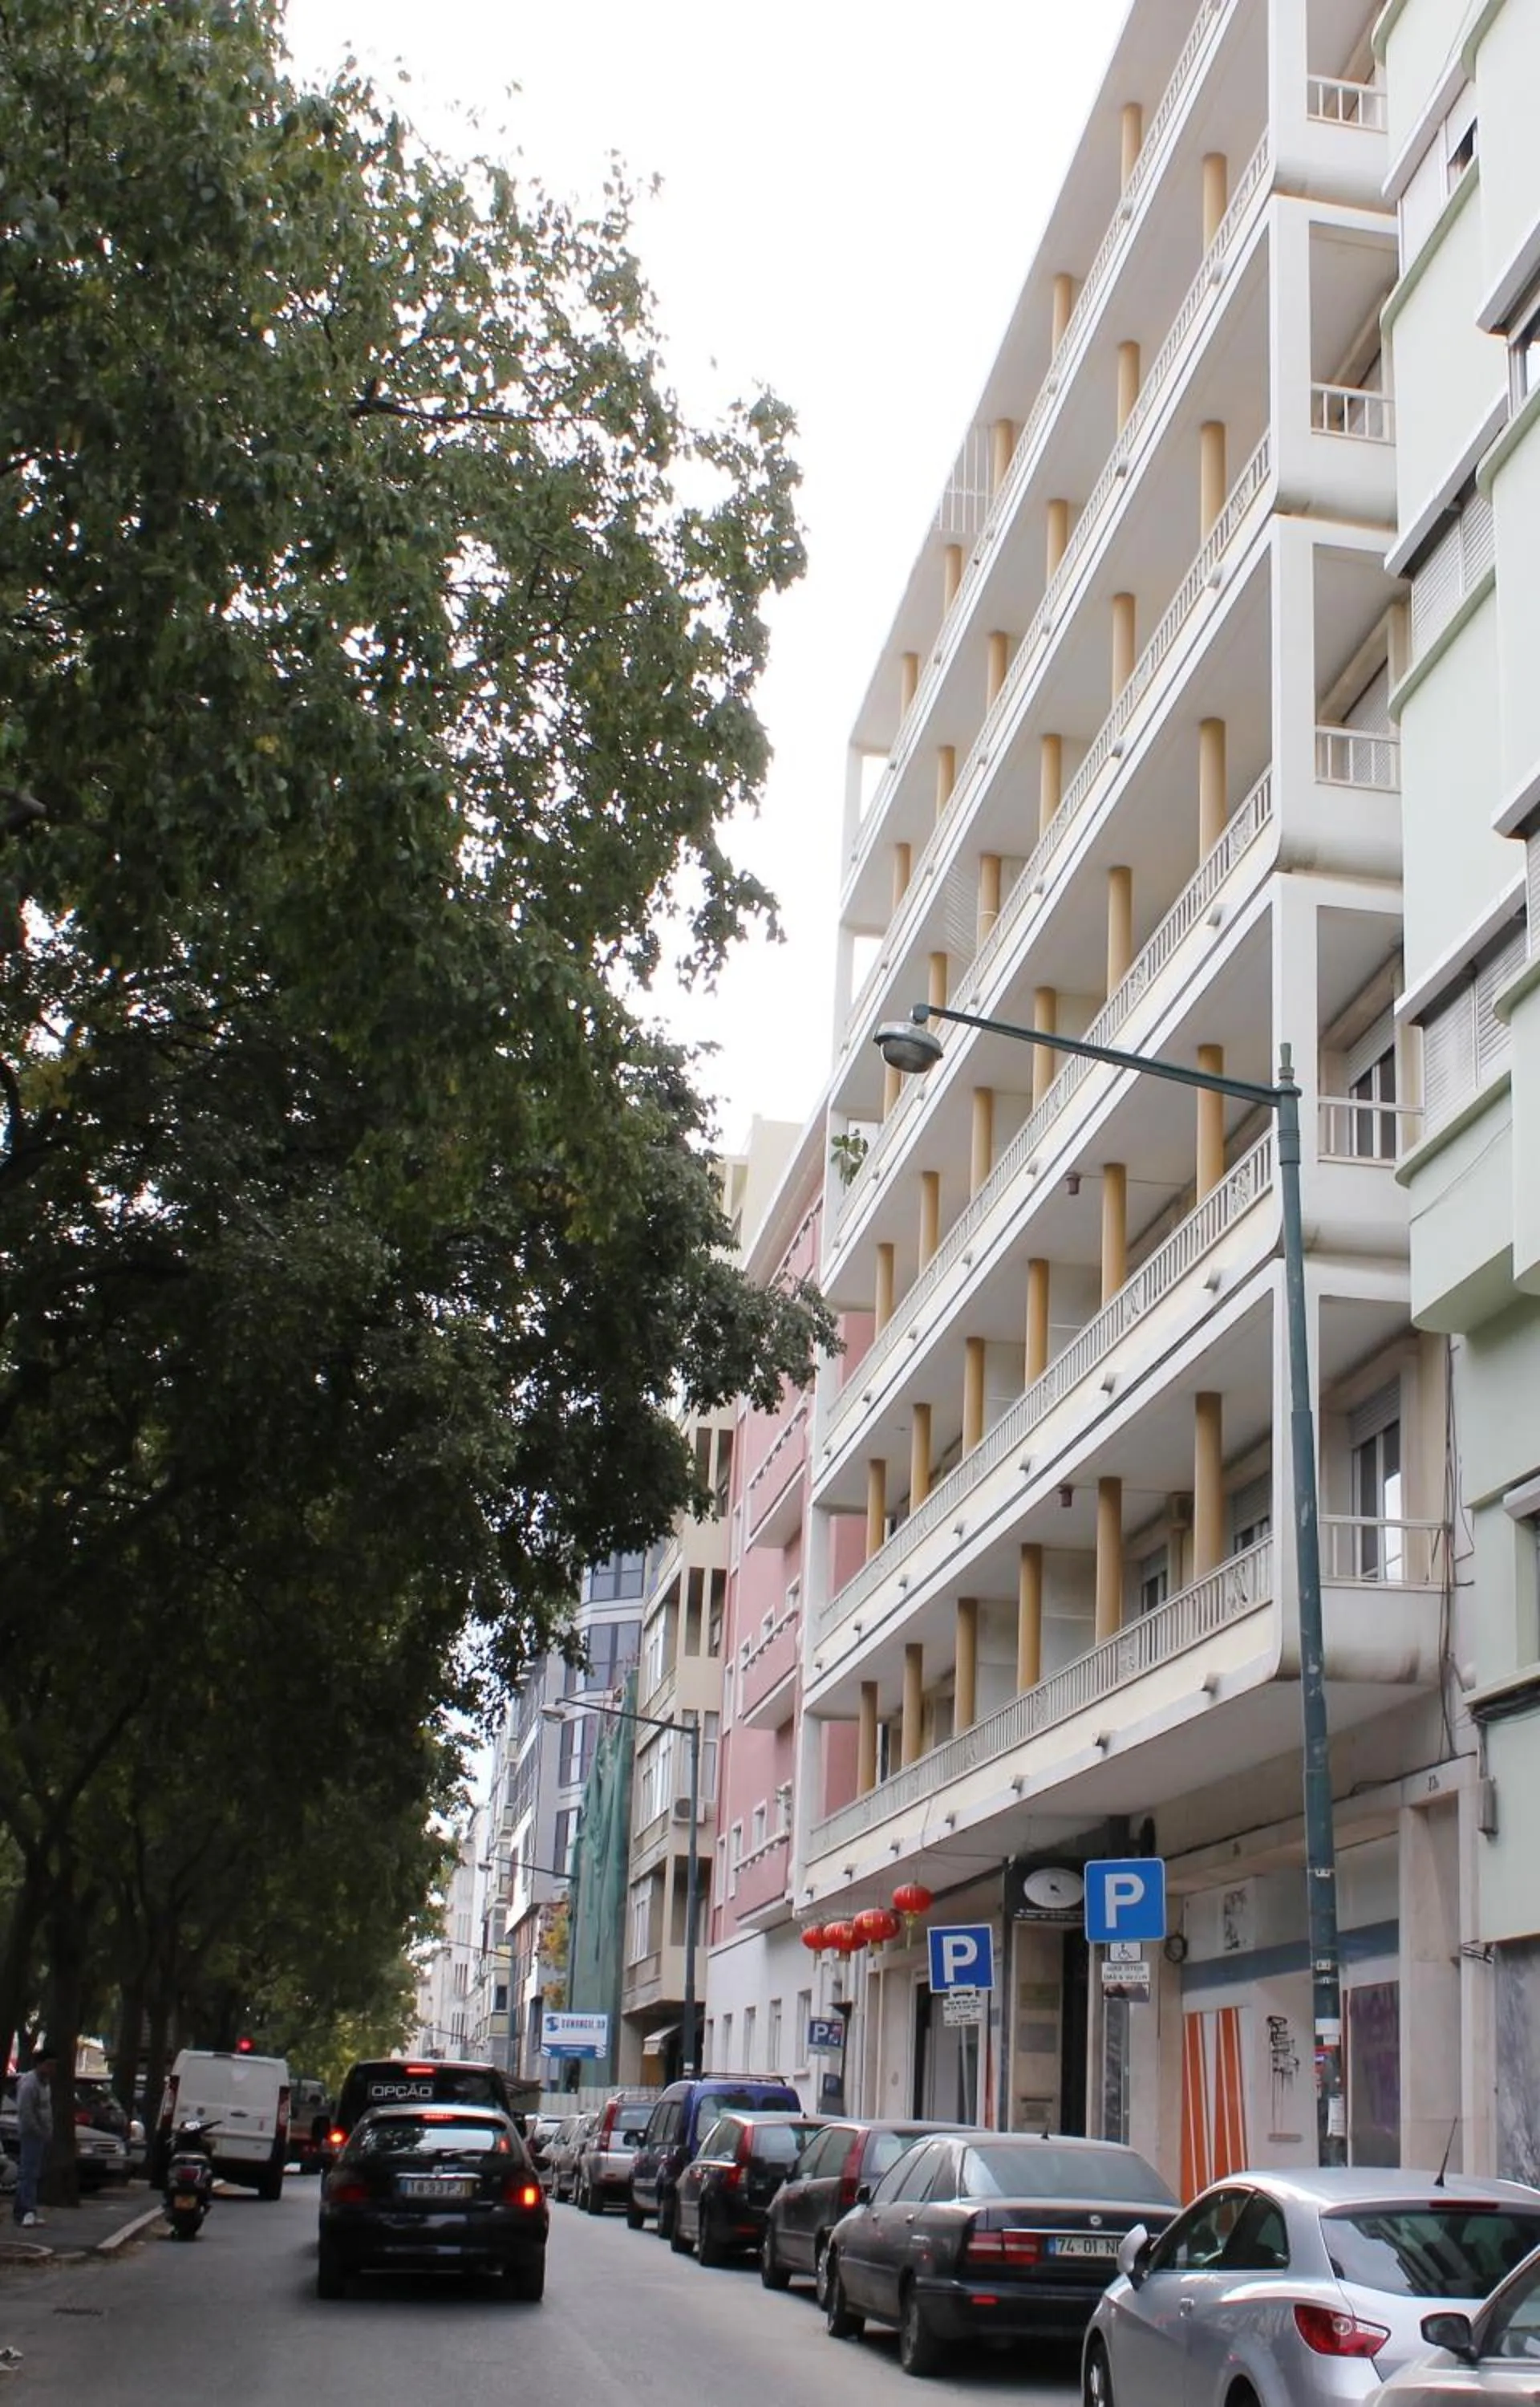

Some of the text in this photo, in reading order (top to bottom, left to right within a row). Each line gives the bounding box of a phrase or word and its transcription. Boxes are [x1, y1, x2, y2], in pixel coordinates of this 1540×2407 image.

[1104, 1873, 1145, 1929] P
[942, 1934, 978, 1983] P
[813, 2023, 829, 2042] P
[371, 2082, 433, 2100] OPÇÃO
